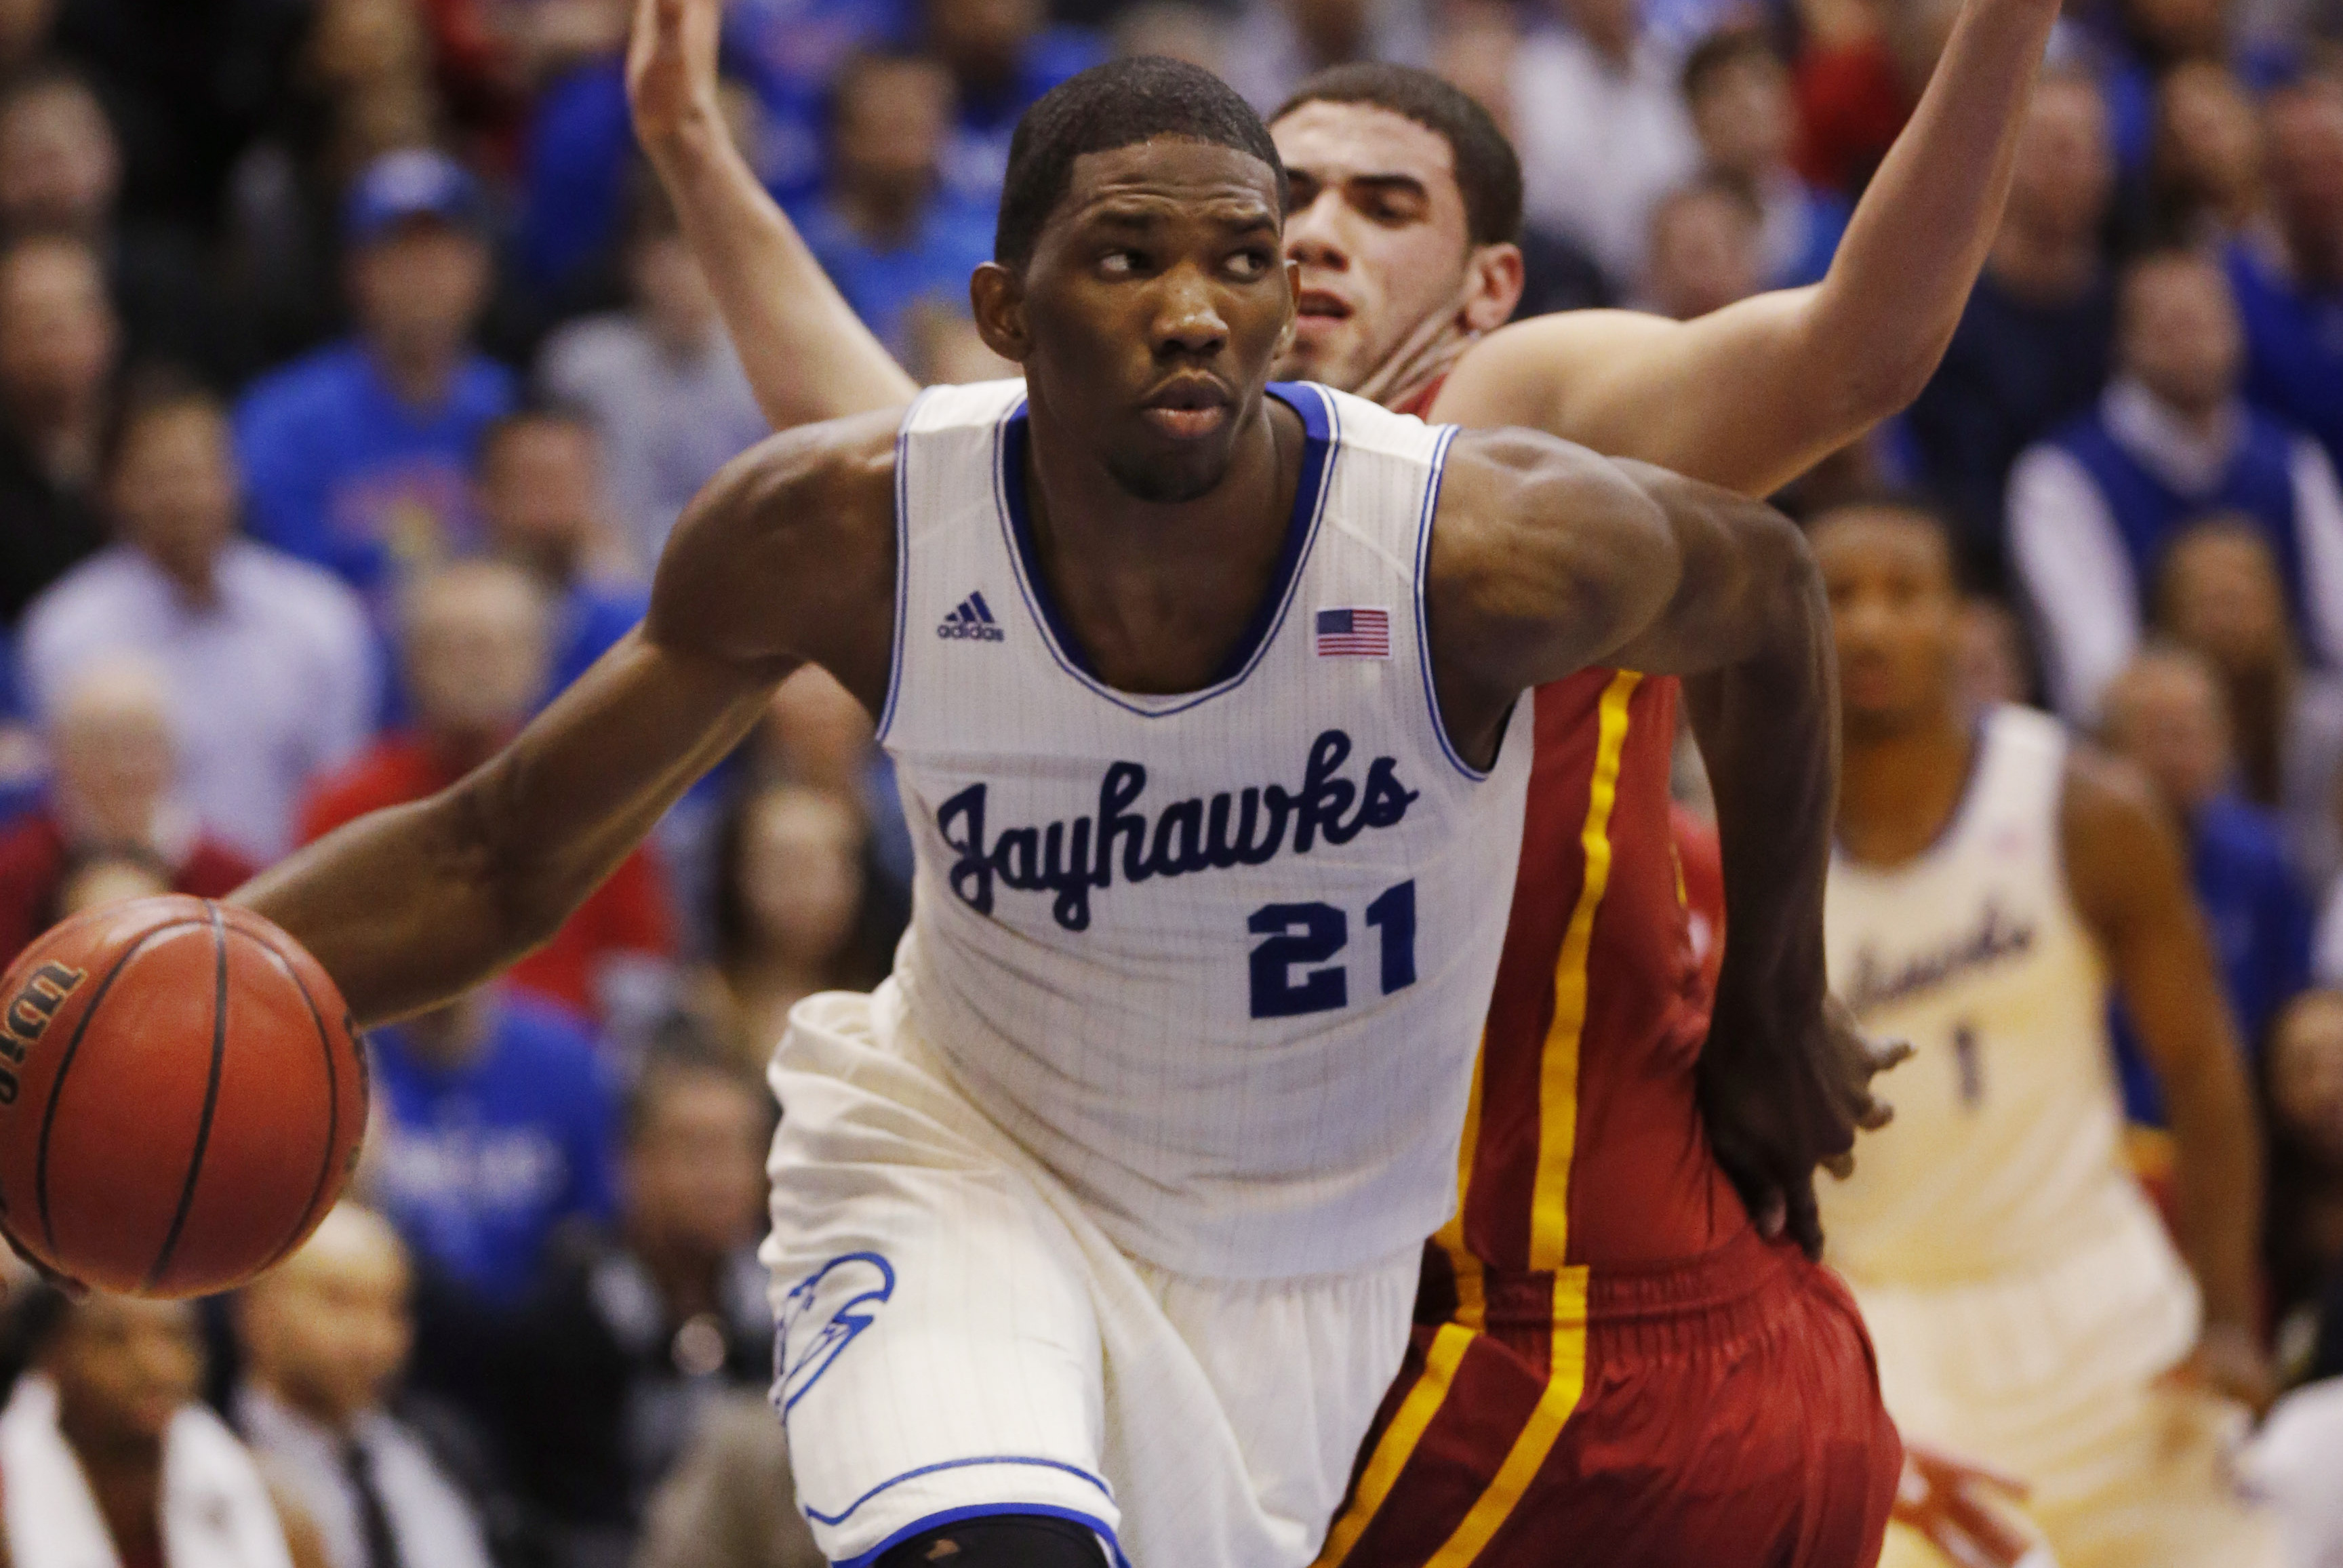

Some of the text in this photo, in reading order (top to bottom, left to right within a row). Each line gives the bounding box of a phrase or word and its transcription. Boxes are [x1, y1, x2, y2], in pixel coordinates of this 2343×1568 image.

[937, 622, 1005, 642] adidas
[936, 729, 1420, 932] Jayhawks
[1247, 879, 1417, 1019] 21
